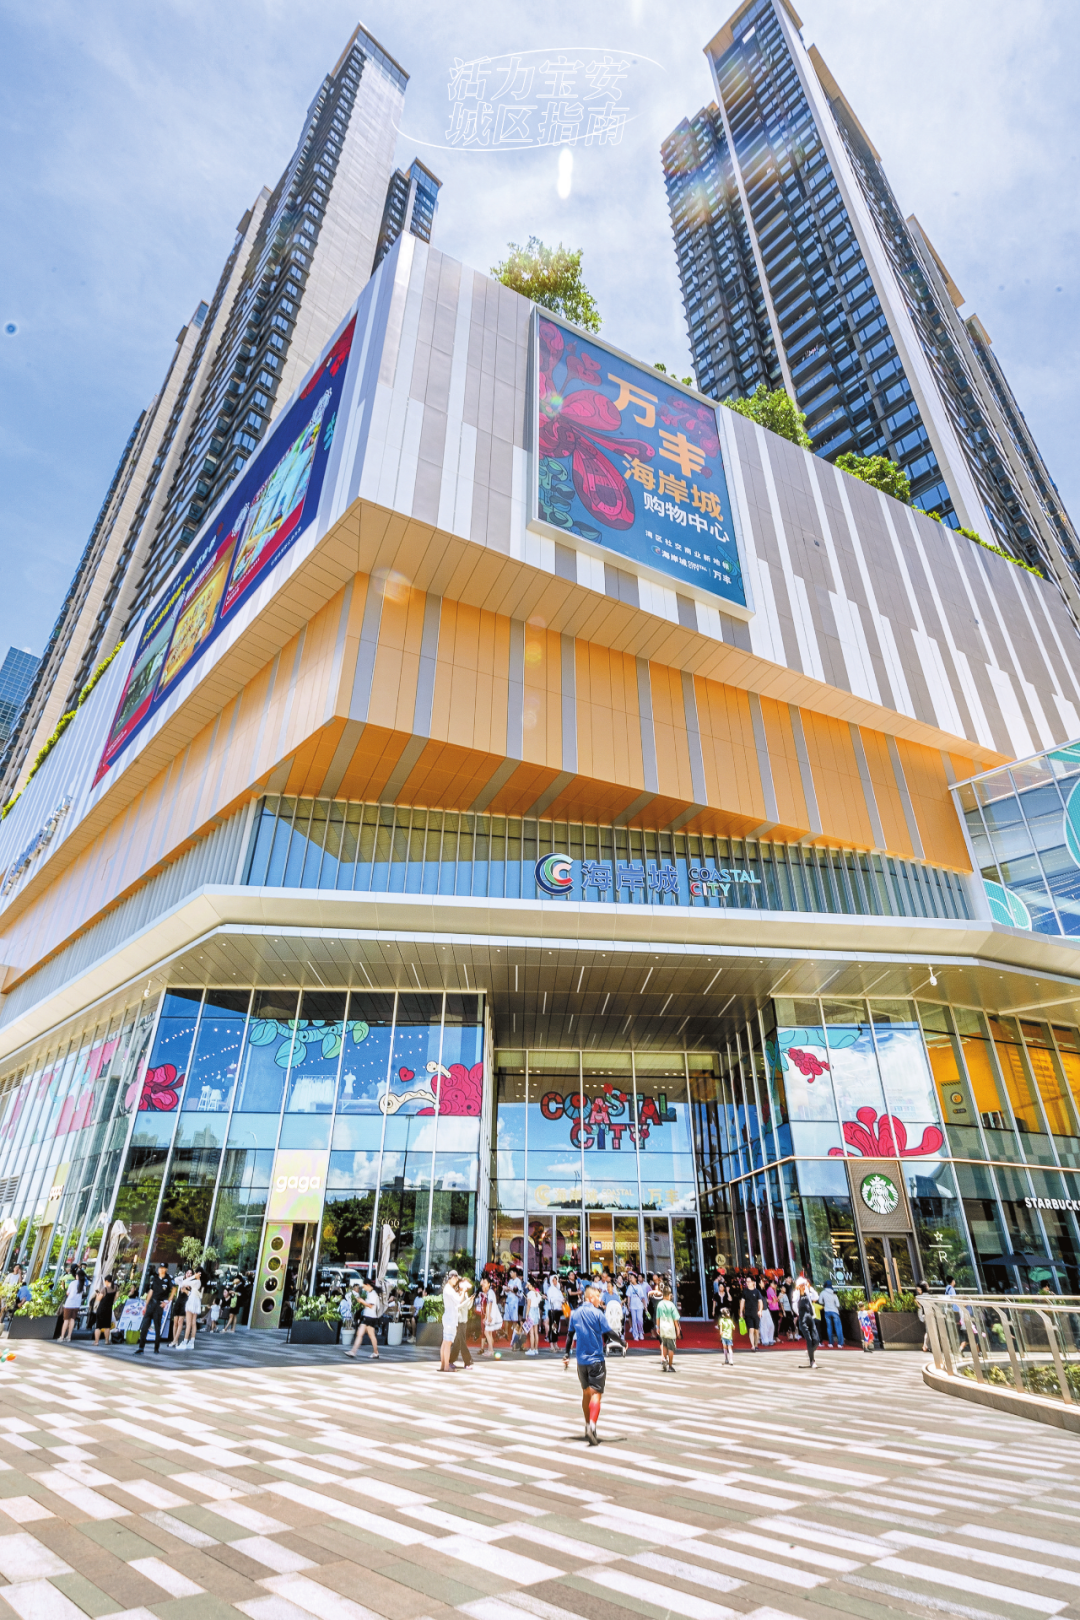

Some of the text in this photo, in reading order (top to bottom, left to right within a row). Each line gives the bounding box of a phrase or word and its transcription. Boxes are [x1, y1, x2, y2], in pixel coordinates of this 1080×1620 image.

[607, 372, 706, 478] 万丰
[623, 453, 724, 522] 海岸城
[643, 492, 730, 543] 购物中心
[645, 529, 730, 570] 湾区社交商业新地标
[661, 549, 687, 568] 海岸城
[712, 569, 732, 585] 万丰
[581, 860, 680, 894] 海岸城
[687, 867, 761, 884] COASTAL
[690, 882, 731, 897] CITY
[540, 1086, 677, 1126] COASTAL
[569, 1122, 650, 1150] CITY
[275, 1174, 321, 1194] gaga
[601, 1188, 634, 1196] COASTAL
[554, 1187, 598, 1204] 海岸城
[648, 1187, 679, 1206] 万丰
[1024, 1196, 1080, 1211] STARBUCK
[829, 1271, 853, 1281] NOW
